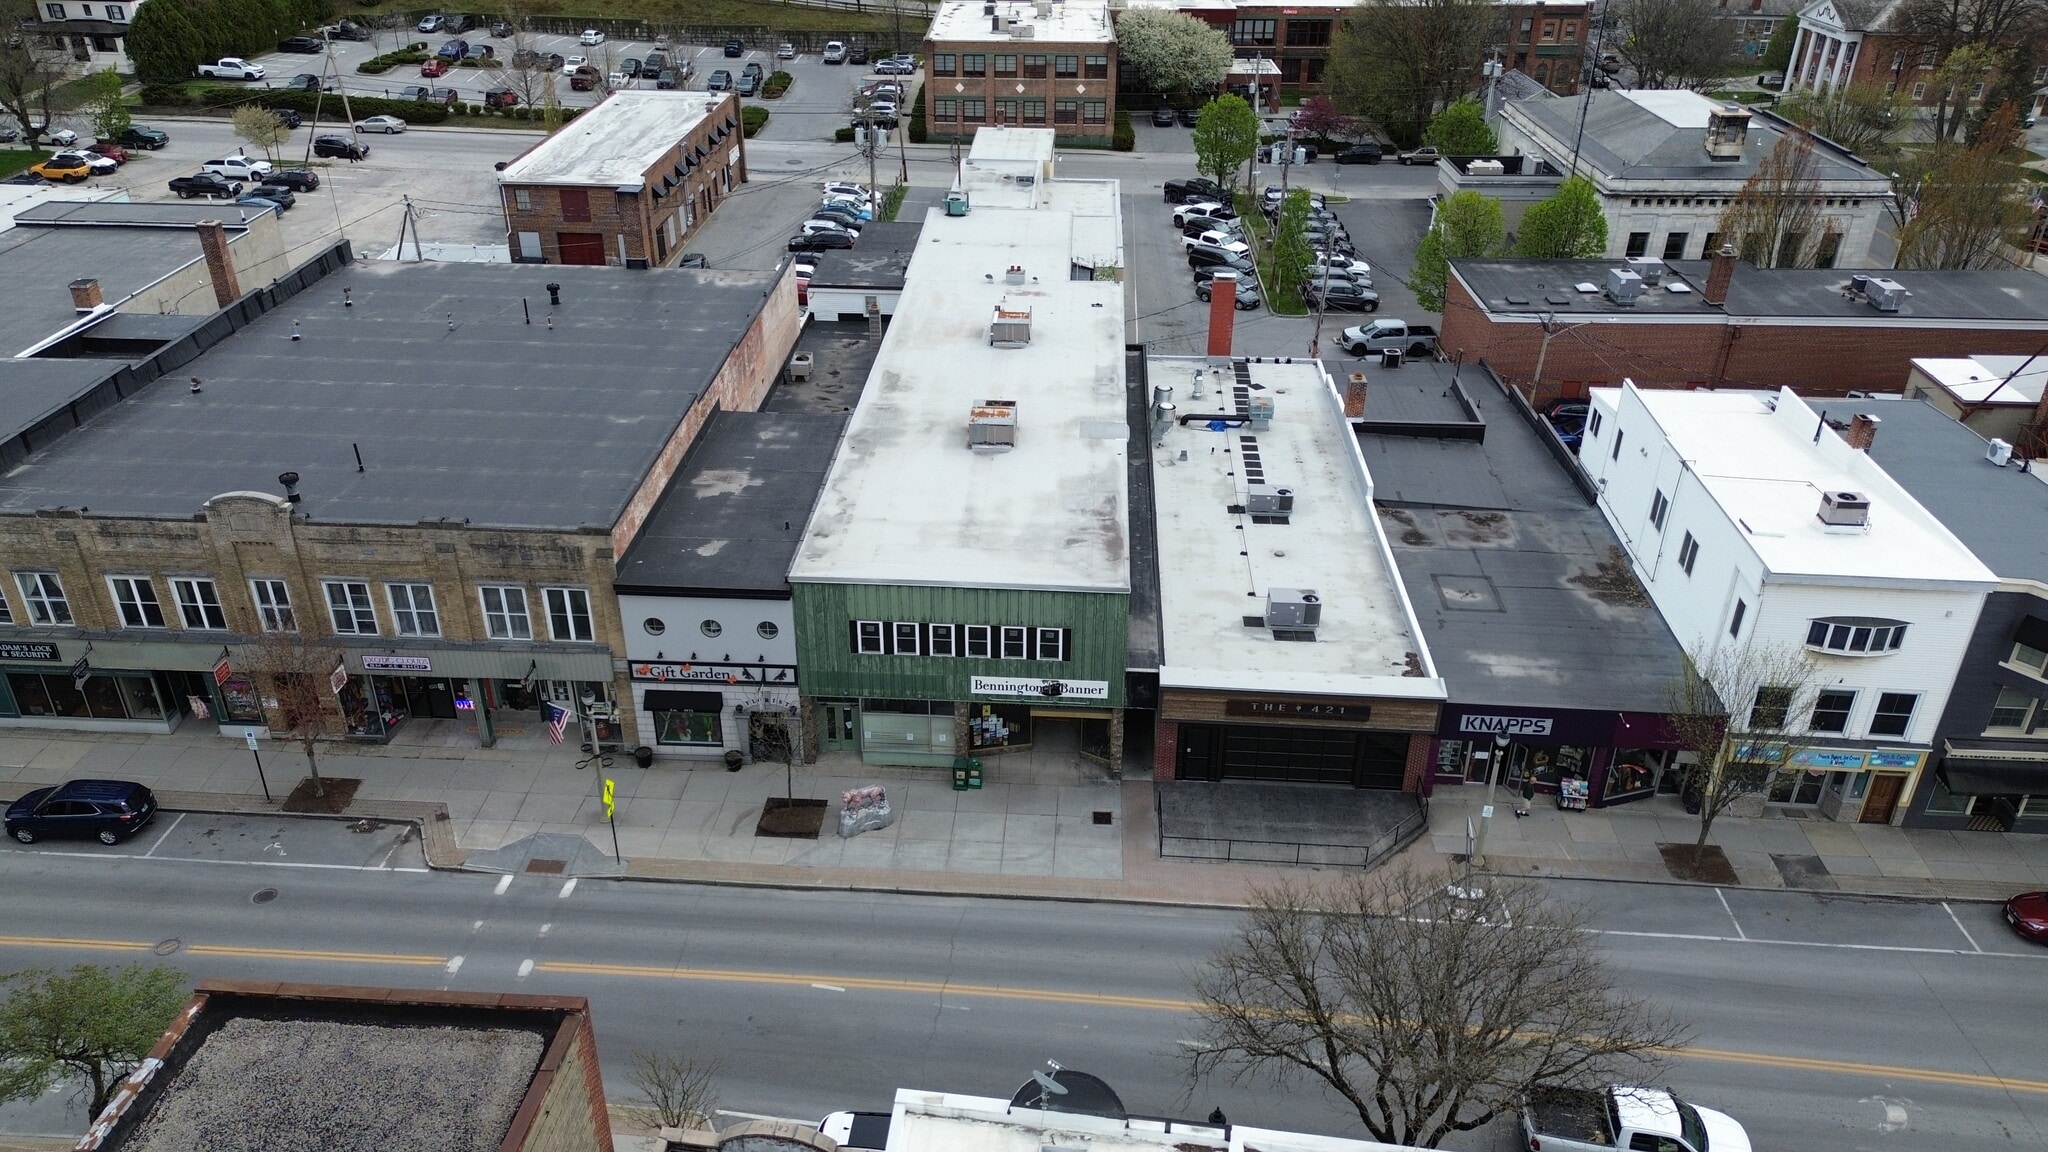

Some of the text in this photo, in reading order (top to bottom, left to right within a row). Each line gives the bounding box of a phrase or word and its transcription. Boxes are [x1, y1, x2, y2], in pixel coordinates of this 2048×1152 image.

[11, 651, 50, 659] SECURITY
[650, 666, 676, 678] Gift
[680, 667, 730, 680] Garden
[975, 680, 1104, 695] Bennington Banner
[1251, 703, 1345, 714] THE 421
[1465, 717, 1546, 733] KNAPPS
